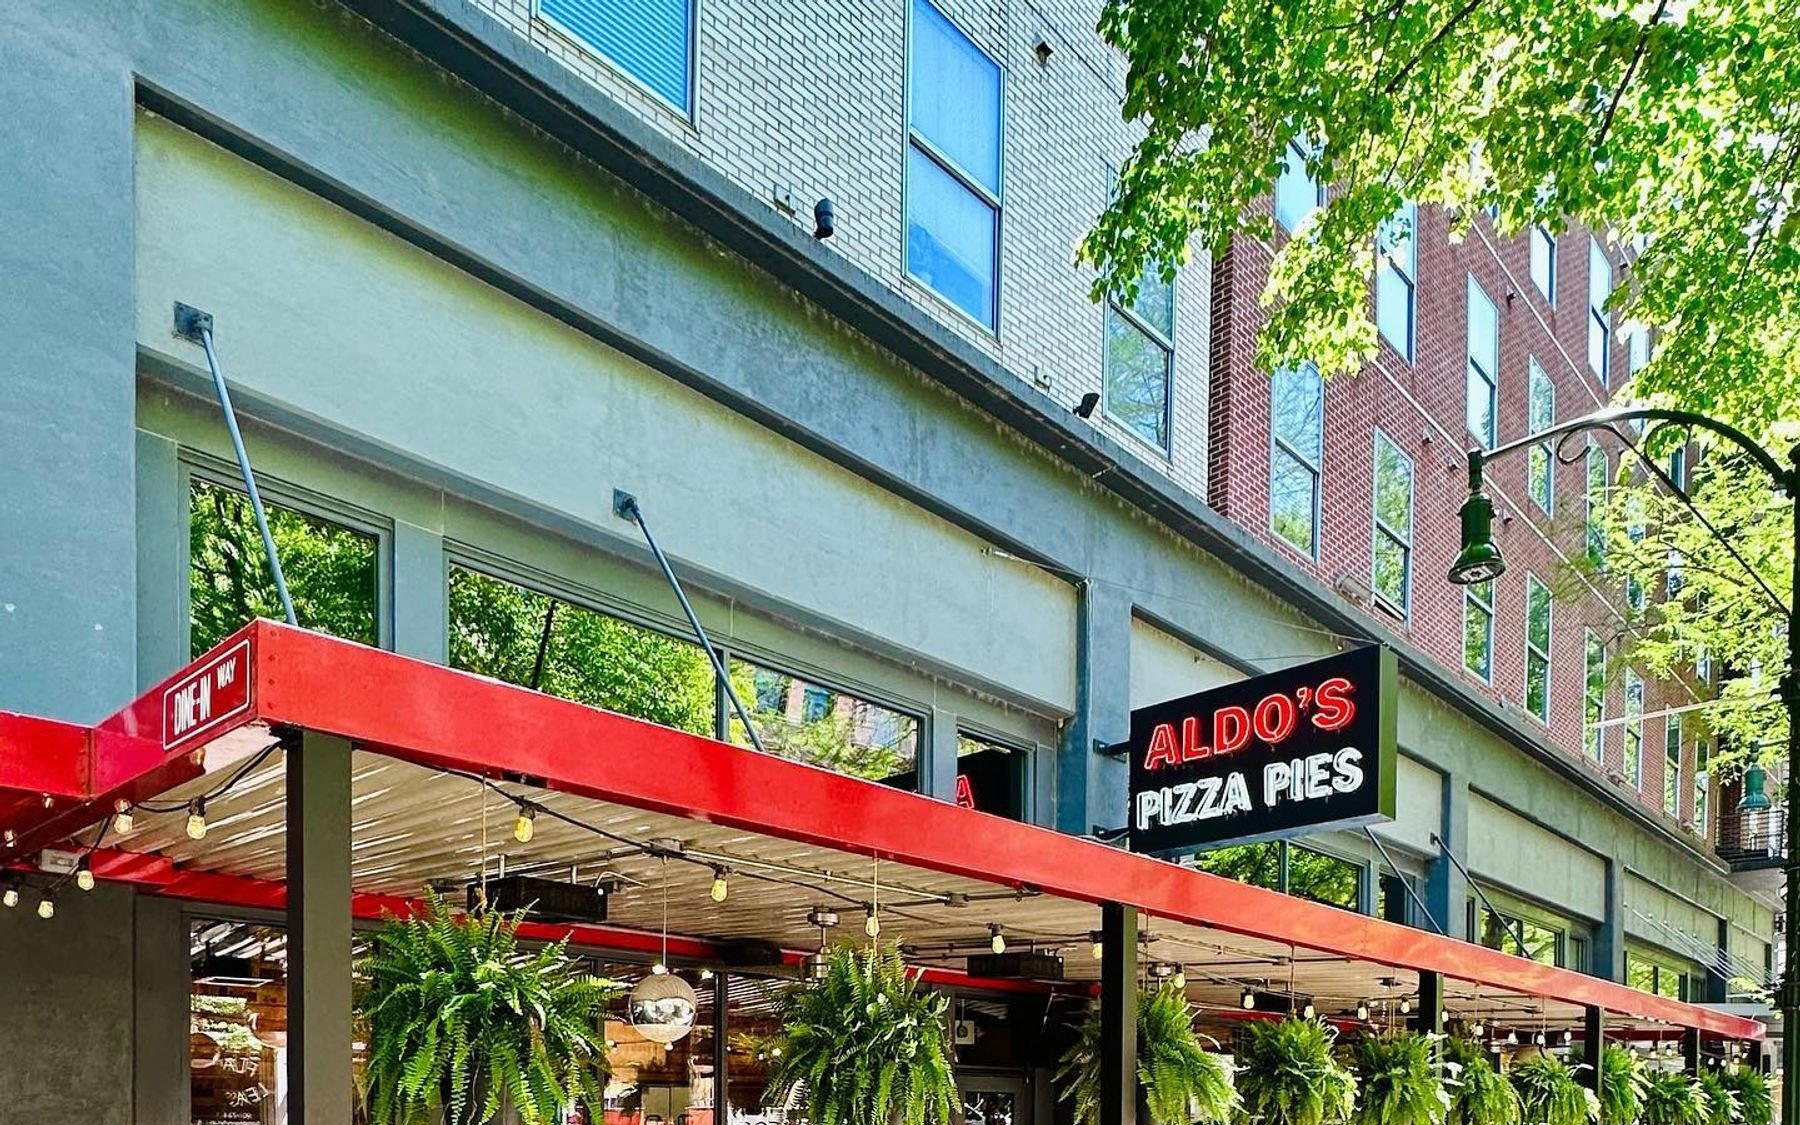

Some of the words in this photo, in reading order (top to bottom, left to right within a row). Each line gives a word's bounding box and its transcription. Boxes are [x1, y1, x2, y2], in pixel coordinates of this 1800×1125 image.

[174, 673, 211, 736] DINE-IN
[217, 657, 237, 690] WAY
[1144, 677, 1356, 771] ALDO'S
[1136, 771, 1253, 831] PIZZA
[1263, 746, 1365, 807] PIES
